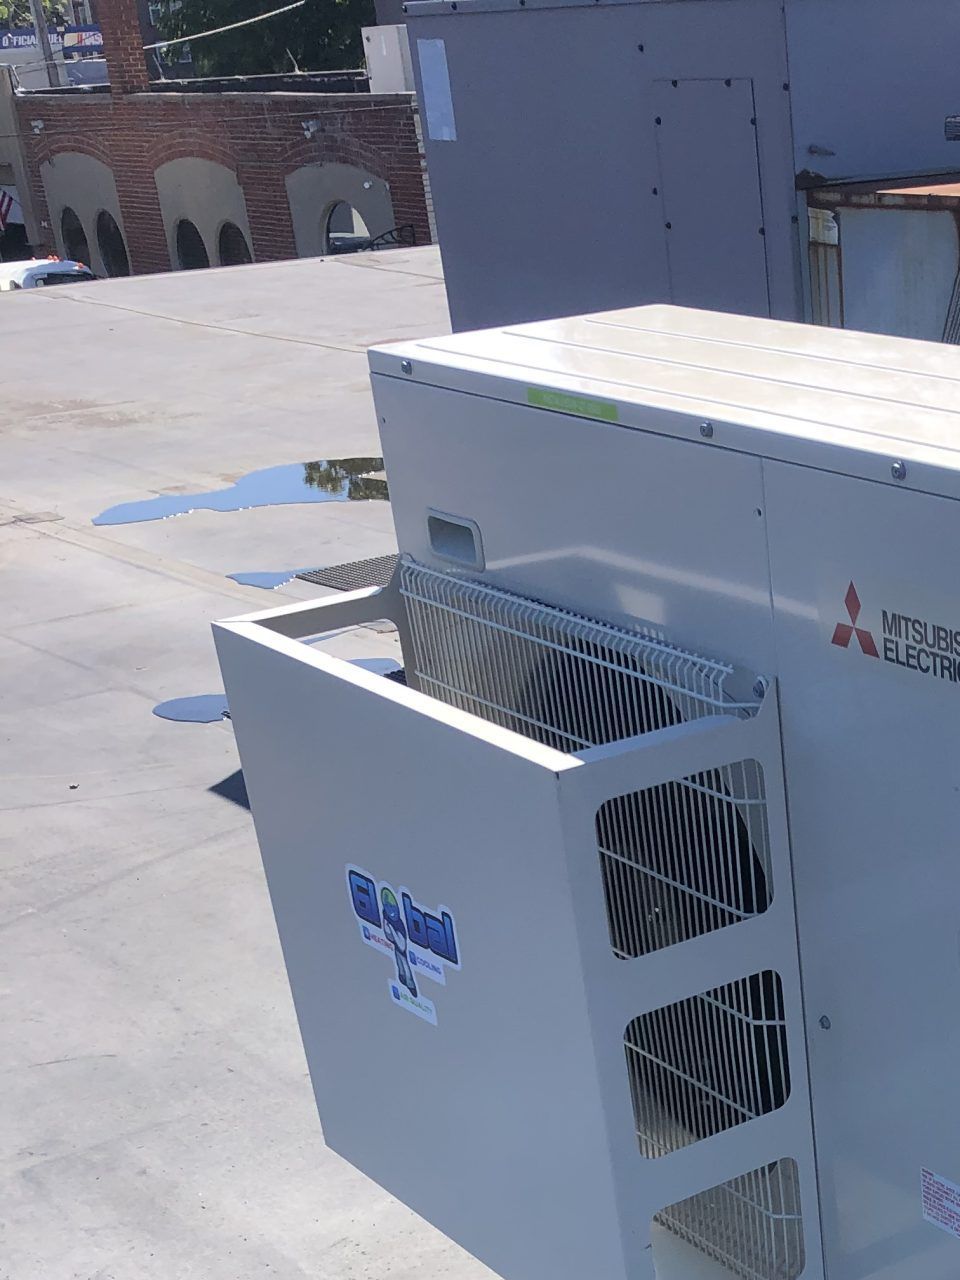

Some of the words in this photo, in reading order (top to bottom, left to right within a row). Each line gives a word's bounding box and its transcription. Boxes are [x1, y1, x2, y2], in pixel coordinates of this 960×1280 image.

[2, 34, 39, 47] OFICIA
[47, 33, 64, 44] UEL
[416, 955, 442, 975] COOLING
